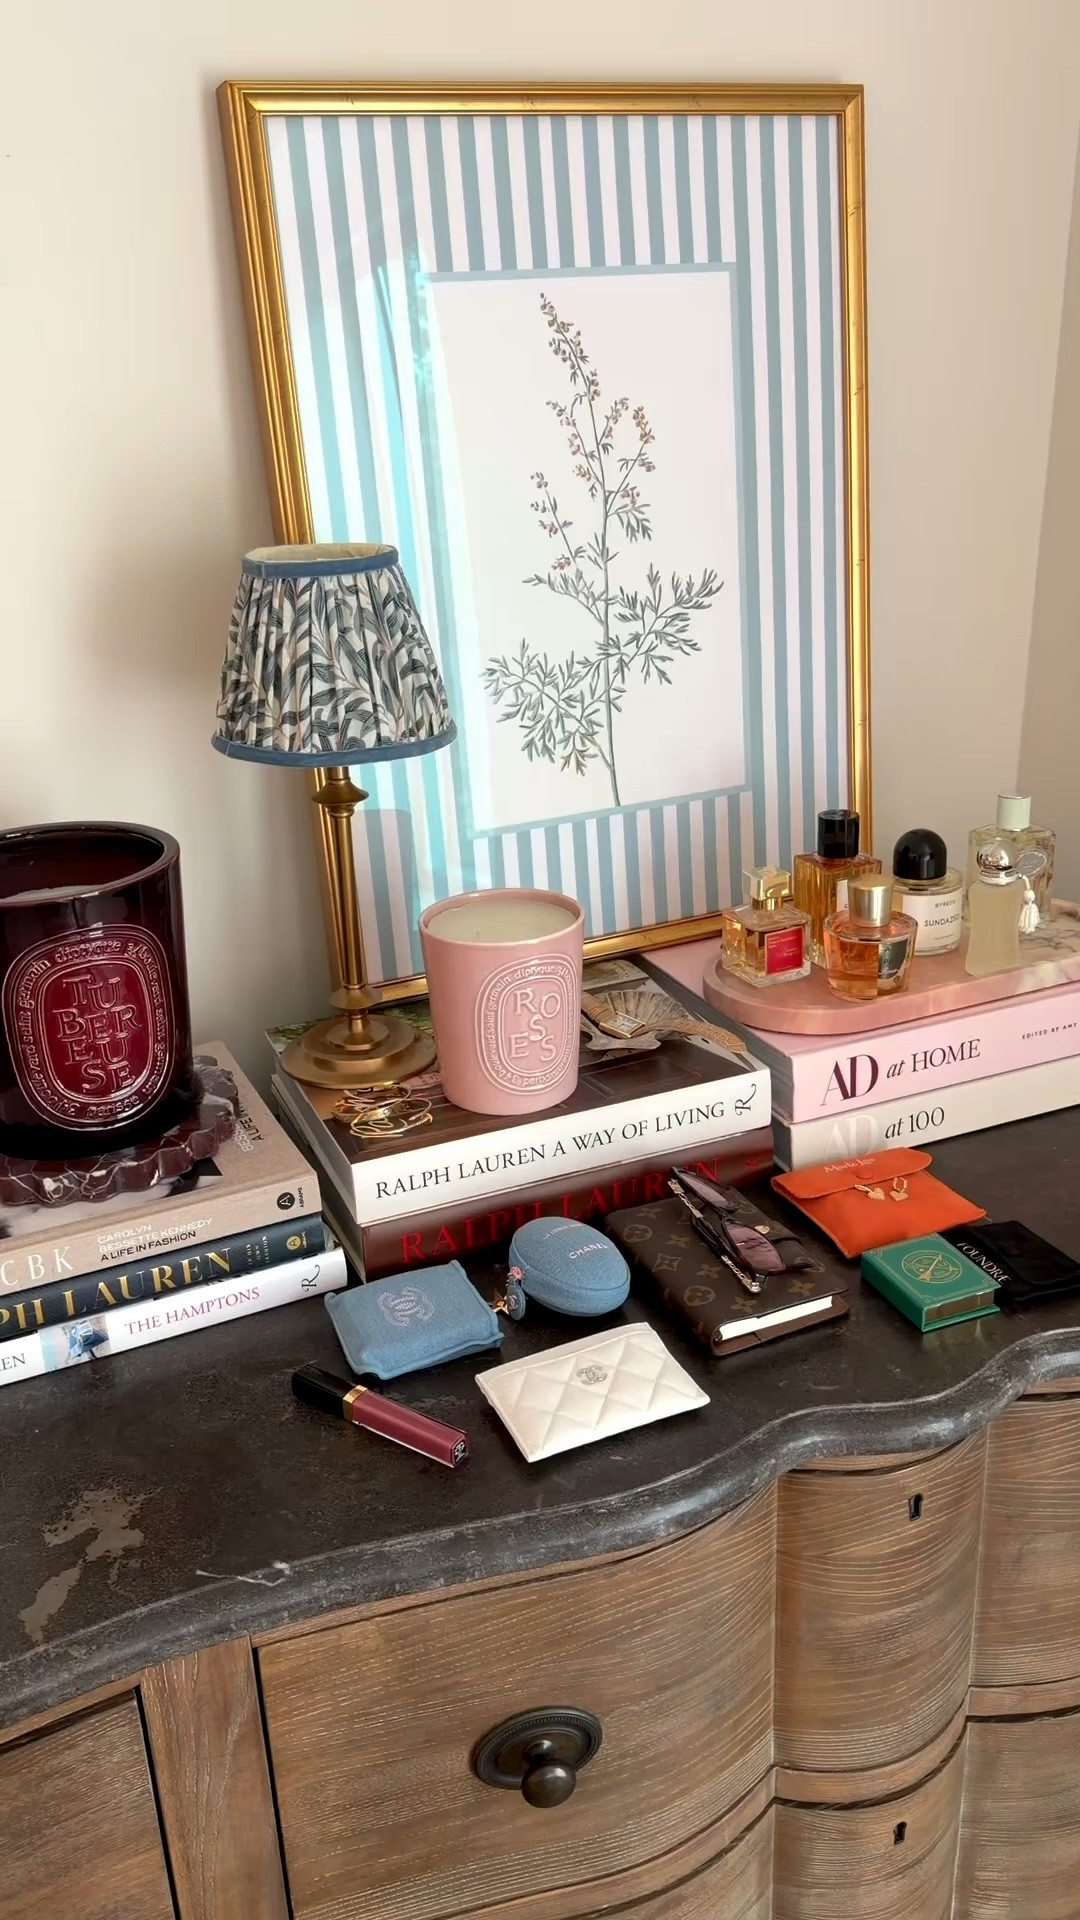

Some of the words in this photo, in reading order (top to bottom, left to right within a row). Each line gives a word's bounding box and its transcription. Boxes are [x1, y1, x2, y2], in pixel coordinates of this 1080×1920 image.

[820, 1053, 879, 1107] AD
[886, 1059, 905, 1079] at
[911, 1038, 981, 1073] HOME
[1022, 1029, 1048, 1040] EDITED
[376, 1165, 451, 1199] RALPH
[458, 1144, 546, 1180] LAUREN
[552, 1140, 567, 1158] A
[572, 1127, 616, 1152] WAY
[621, 1119, 649, 1140] OF
[654, 1101, 725, 1133] LIVING
[824, 1114, 879, 1158] AD
[885, 1117, 904, 1140] at
[908, 1106, 945, 1134] 100
[561, 1156, 723, 1219] LAURN
[97, 1223, 152, 1243] CAROLYN
[99, 1232, 159, 1253] BESSETTE
[160, 1217, 213, 1237] KENNEDY
[100, 1254, 109, 1262] A
[110, 1246, 134, 1259] LIFE
[136, 1243, 147, 1253] IN
[148, 1230, 197, 1250] FASHION
[568, 1242, 609, 1259] CHANEL
[1, 1246, 74, 1286] CBK
[62, 1247, 232, 1318] LAUREN
[0, 1353, 26, 1371] EN
[124, 1316, 162, 1335] THE
[166, 1287, 261, 1324] HAMPTONS
